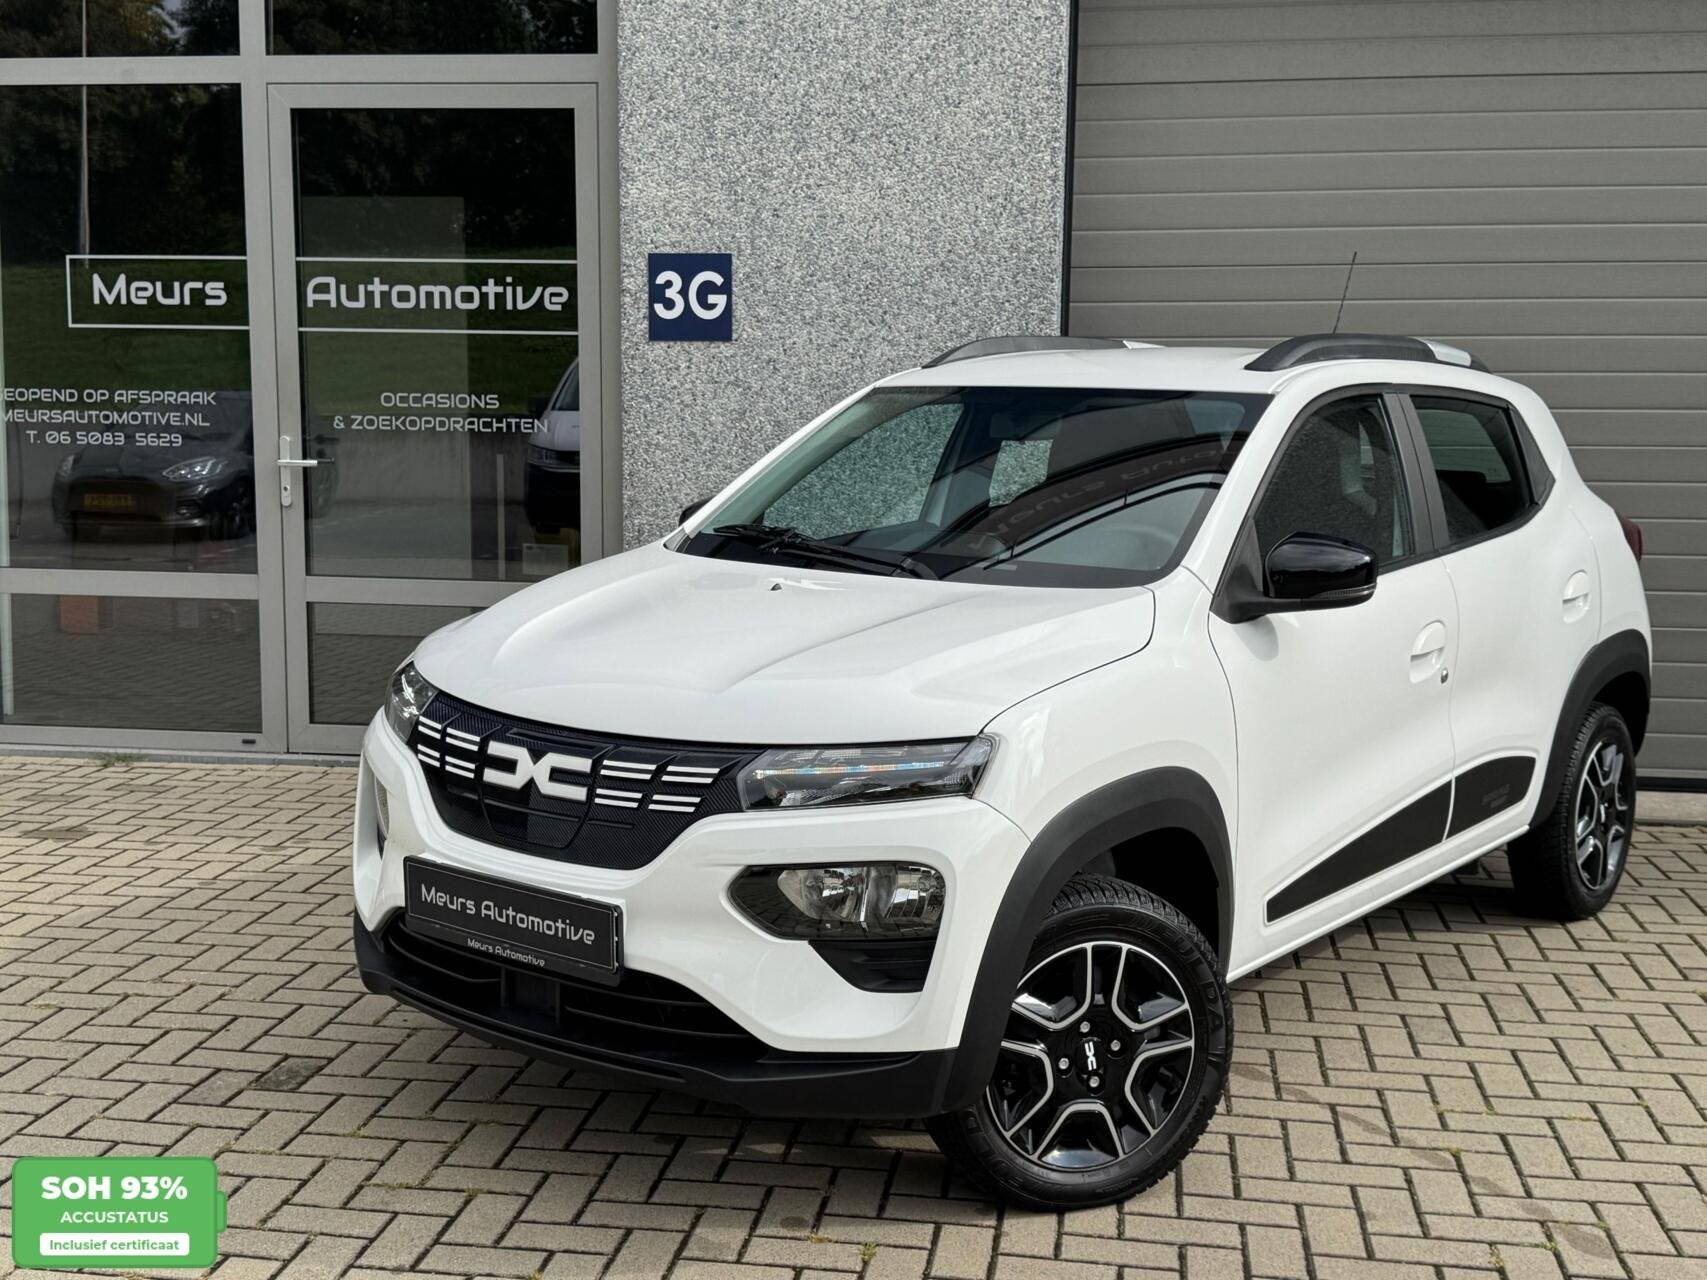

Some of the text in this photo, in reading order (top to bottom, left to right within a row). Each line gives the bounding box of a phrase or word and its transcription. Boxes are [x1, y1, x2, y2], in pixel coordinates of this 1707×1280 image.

[92, 272, 569, 311] Meurs Automotive
[653, 270, 727, 320] 3G
[0, 388, 217, 405] EOPEND OP AFSPRAAK
[380, 392, 500, 409] OCCASIONS
[333, 415, 548, 433] & ZOEKOPDRACHTEN
[26, 430, 182, 446] T. 06 5083 5629
[420, 883, 596, 945] Meurs Automotive
[467, 938, 546, 968] Meurs Automotive
